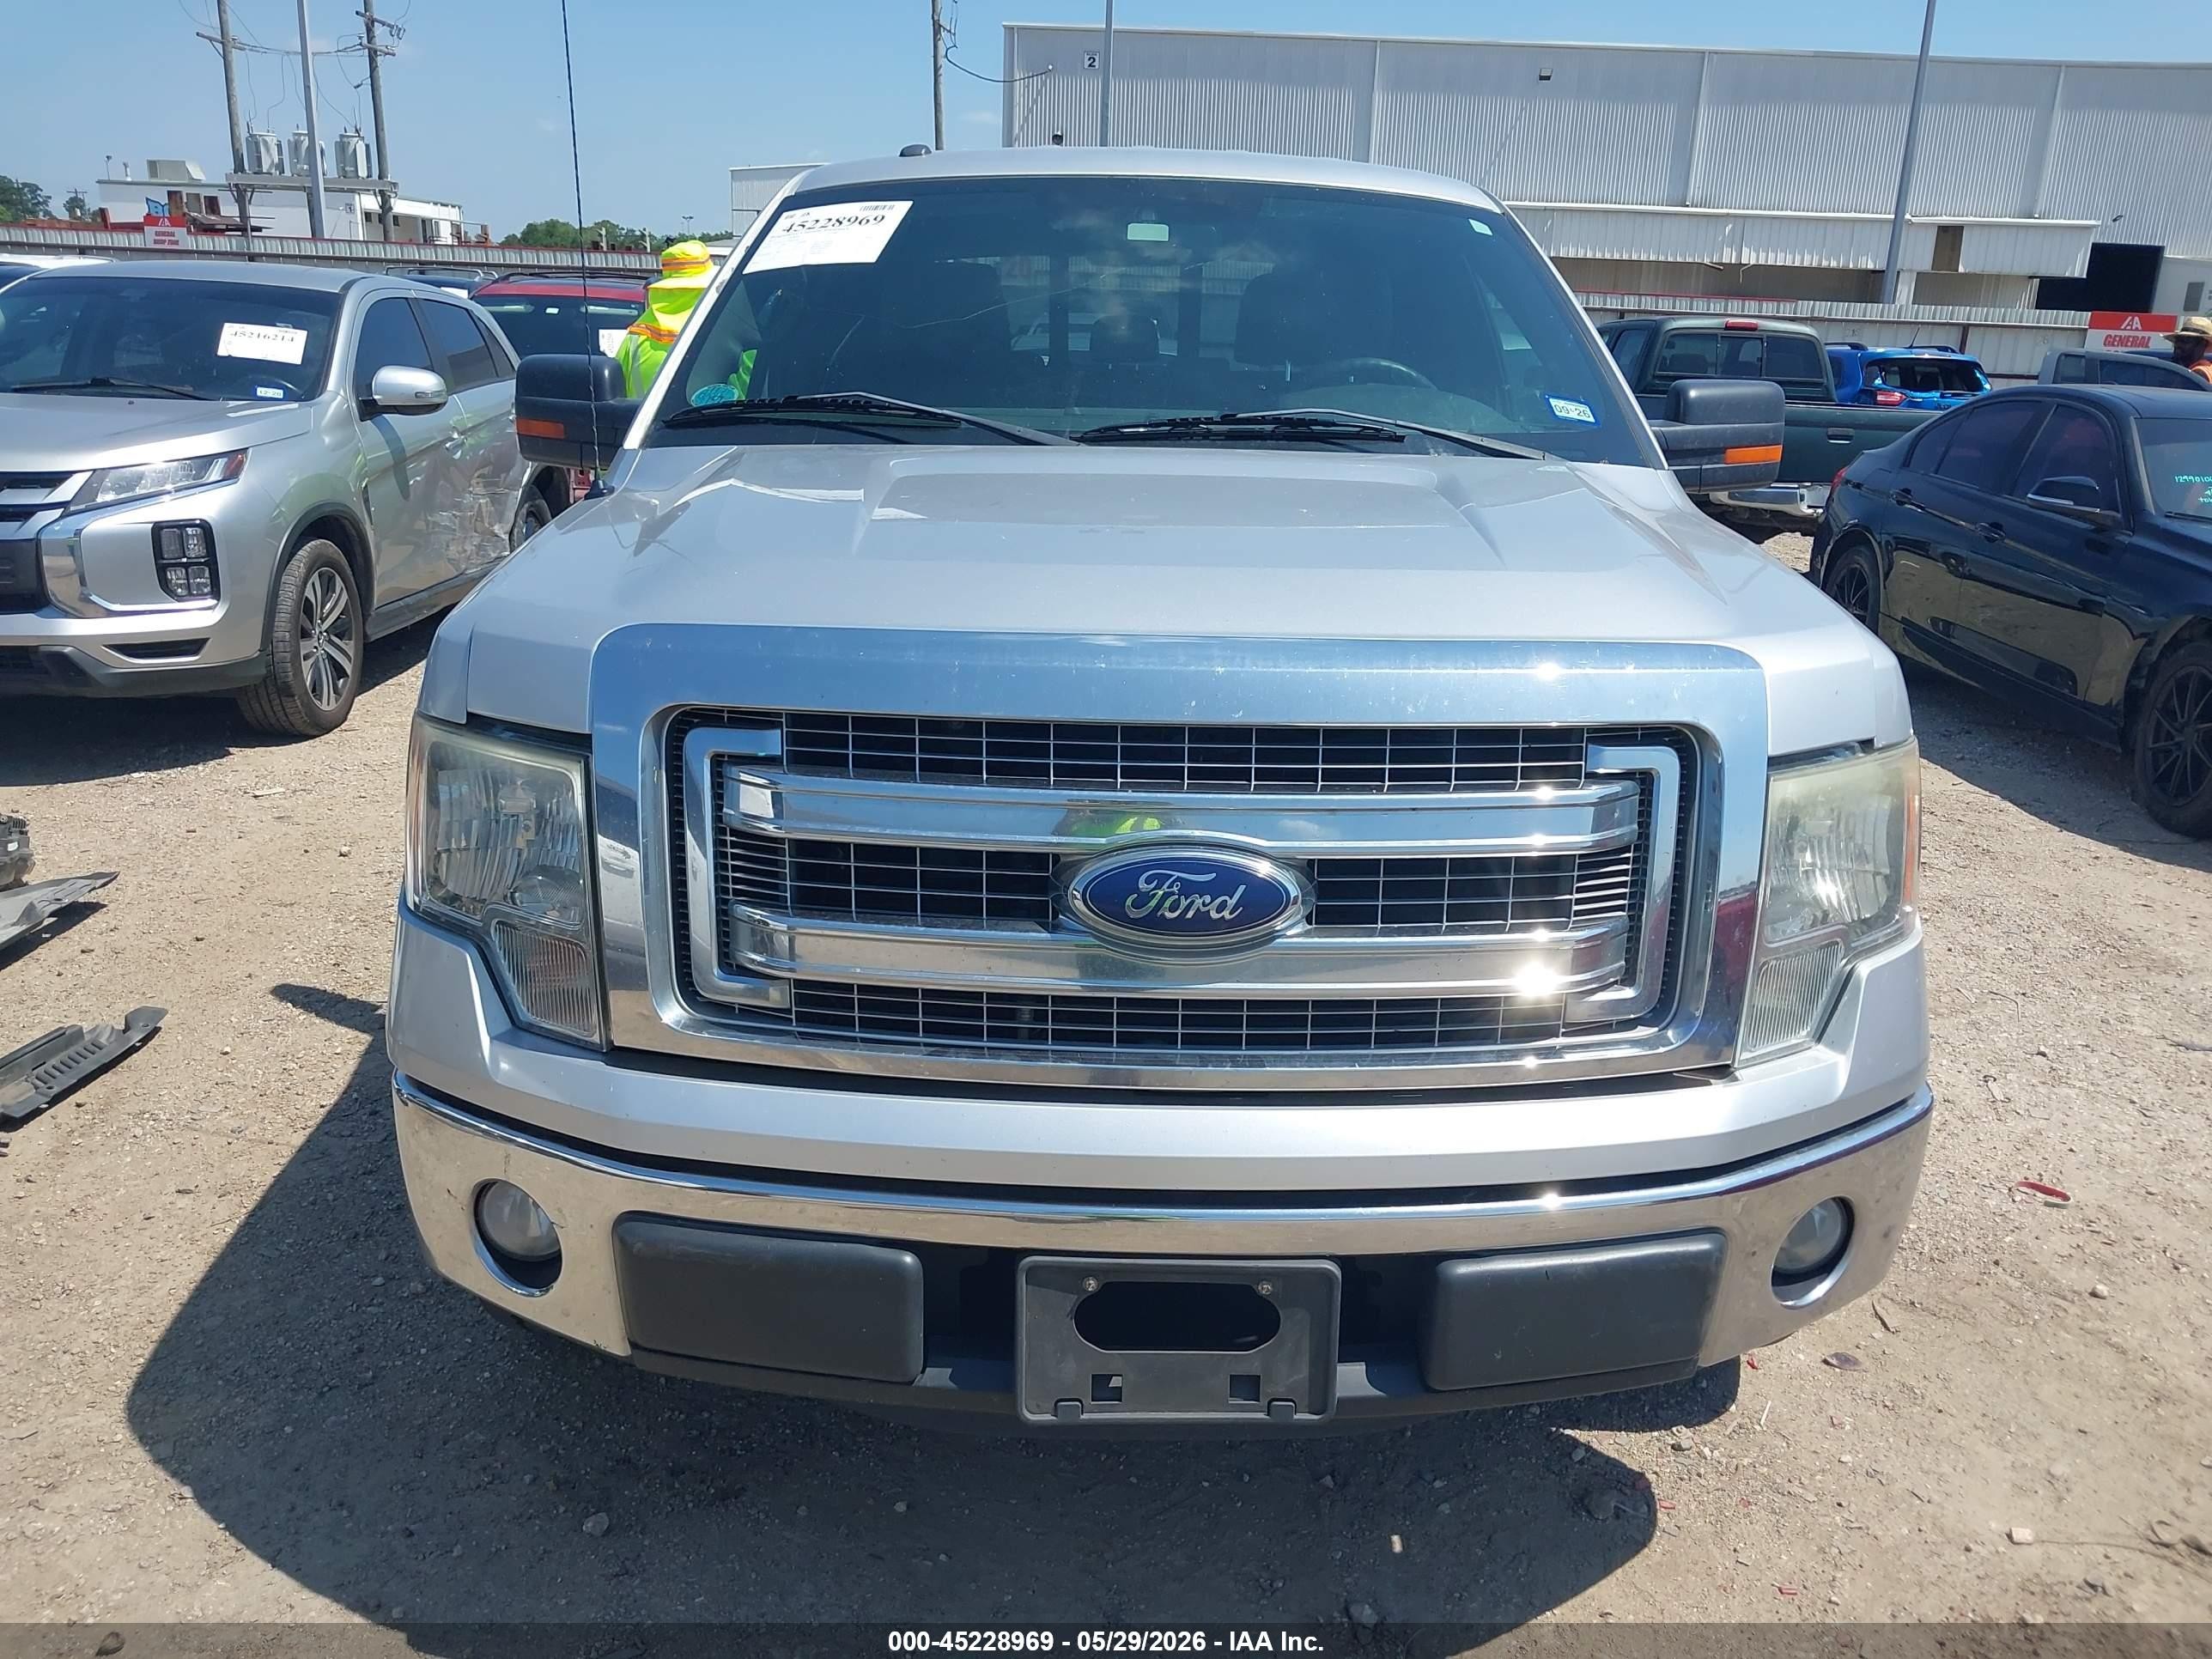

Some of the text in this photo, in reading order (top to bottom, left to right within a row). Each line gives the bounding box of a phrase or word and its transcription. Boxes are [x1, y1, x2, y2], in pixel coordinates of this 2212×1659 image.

[1087, 56, 1097, 68] 2
[782, 214, 886, 234] 45228969
[230, 330, 295, 343] 45216214
[2103, 333, 2152, 349] GENERAL
[1553, 404, 1591, 418] 09-26
[1125, 869, 1248, 920] Ford
